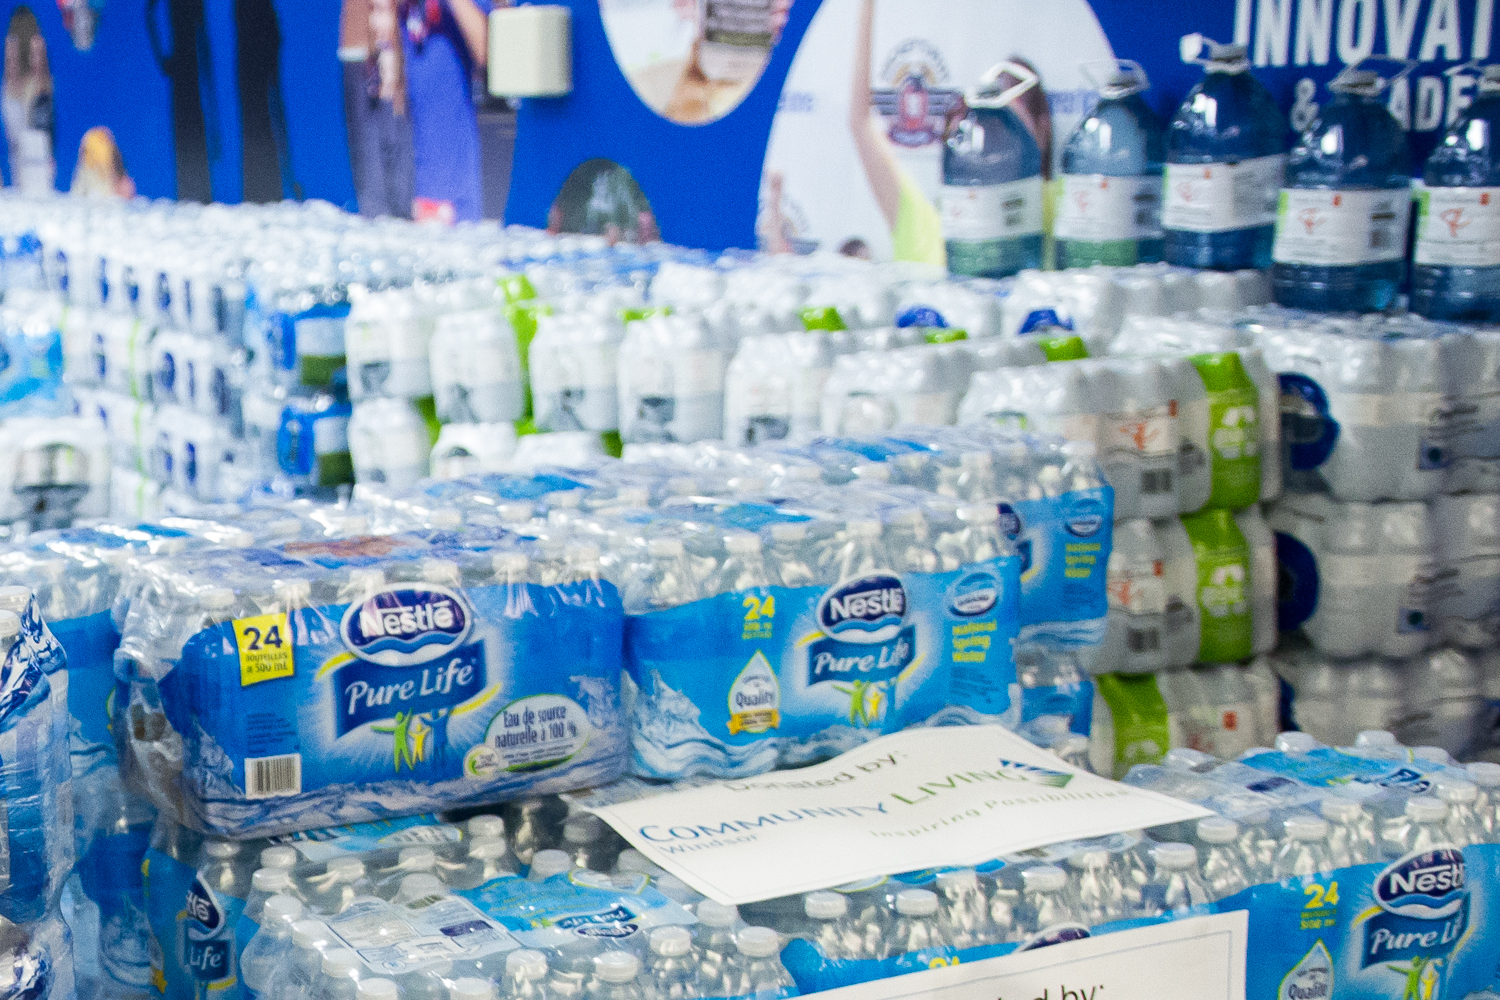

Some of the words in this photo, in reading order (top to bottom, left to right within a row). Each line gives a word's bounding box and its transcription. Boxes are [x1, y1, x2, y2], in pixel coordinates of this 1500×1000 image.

[359, 600, 456, 638] Nestlé
[742, 596, 775, 621] 24
[243, 624, 283, 651] 24
[814, 651, 876, 676] Pure
[344, 680, 415, 715] Pure
[419, 658, 474, 699] Life
[503, 709, 522, 729] Eau
[524, 706, 536, 727] de
[537, 706, 567, 724] source
[494, 726, 538, 748] naturelle
[638, 801, 889, 844] COMMUNITY
[890, 759, 1029, 806] LIVING
[1303, 881, 1340, 909] 24
[189, 946, 222, 970] Life
